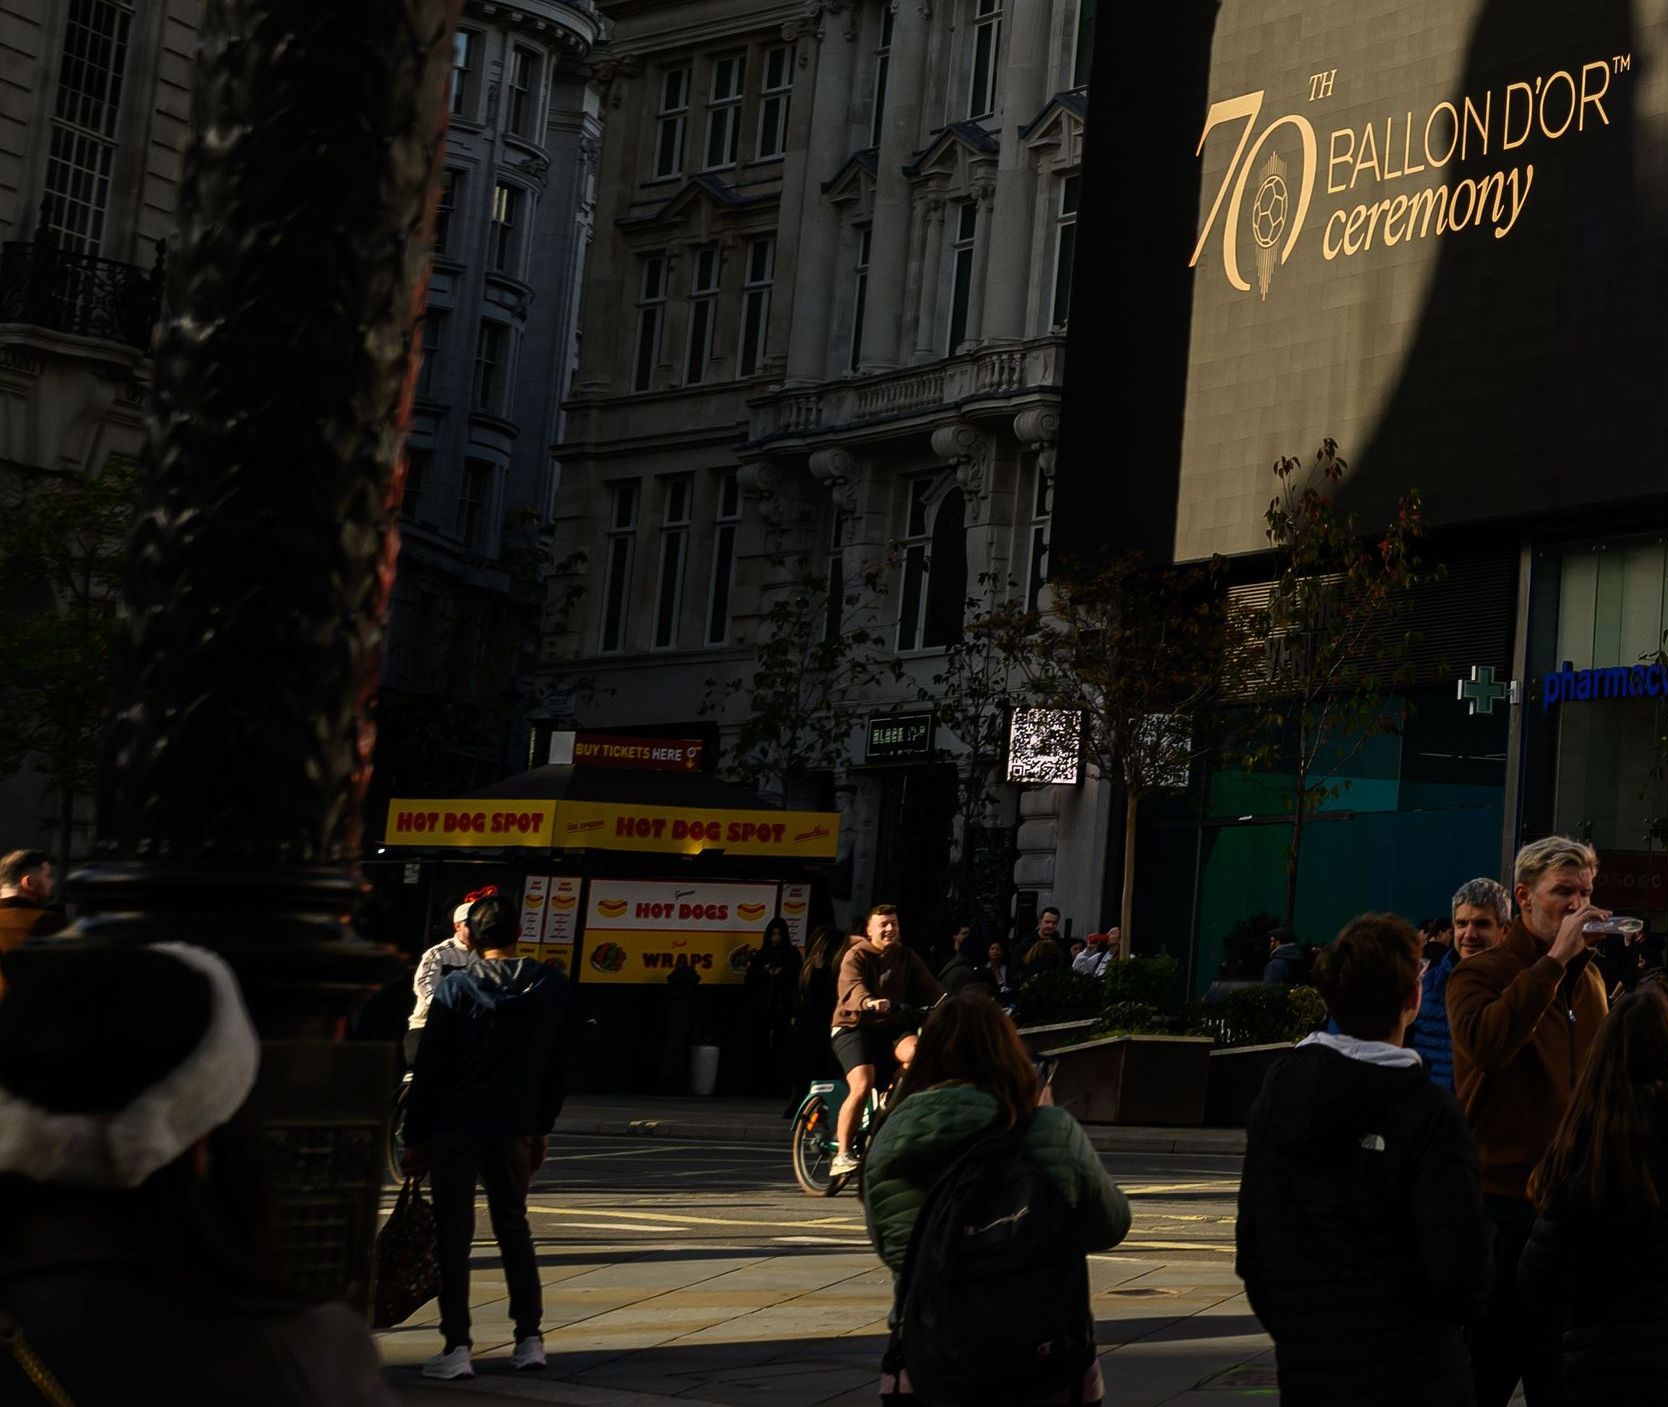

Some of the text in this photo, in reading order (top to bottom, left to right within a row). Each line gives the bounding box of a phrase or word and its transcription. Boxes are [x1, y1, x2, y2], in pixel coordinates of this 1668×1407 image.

[1328, 90, 1492, 195] BALLON
[1188, 68, 1338, 292] 70 TH
[1323, 164, 1535, 262] ceremony
[575, 743, 683, 762] BUY TICKETS HERE
[397, 811, 545, 834] HOT DOG SPOT
[616, 816, 667, 839] HOT
[672, 819, 722, 842] DOG
[727, 821, 787, 844] SPOT
[635, 902, 729, 921] HOT DOGS
[642, 952, 713, 970] WRAPS
